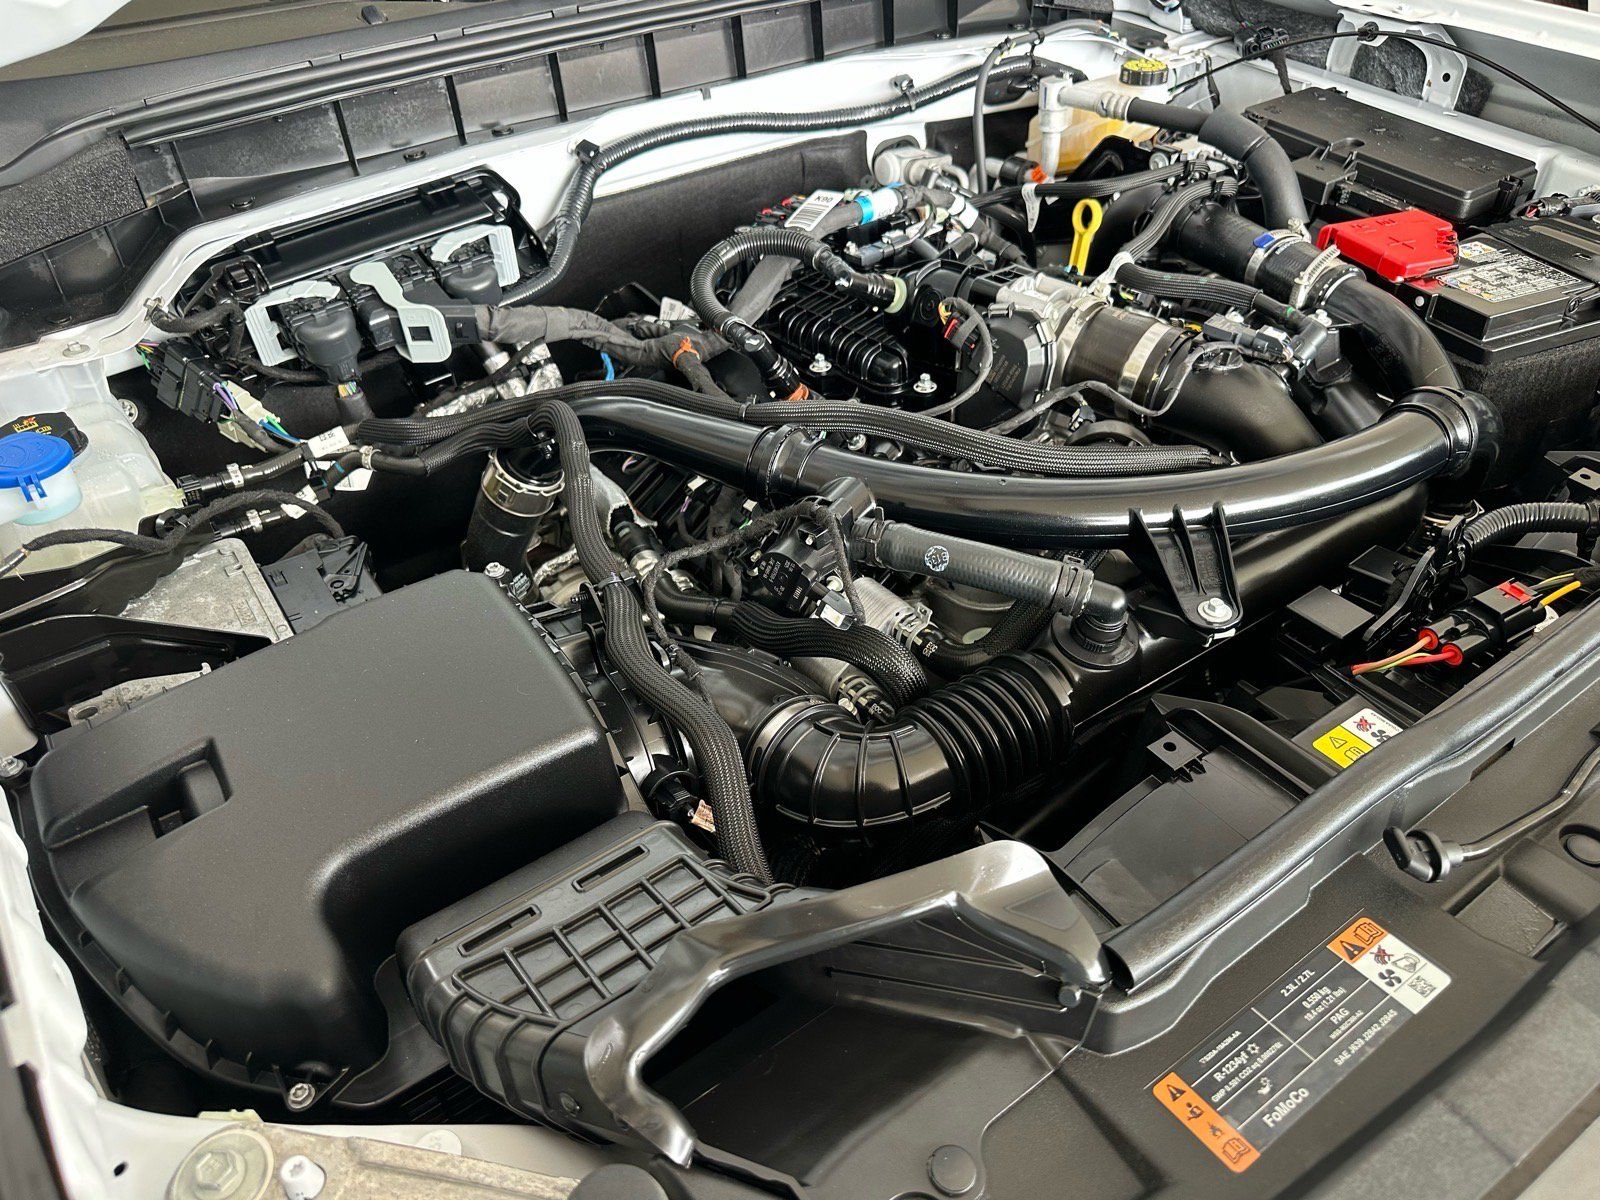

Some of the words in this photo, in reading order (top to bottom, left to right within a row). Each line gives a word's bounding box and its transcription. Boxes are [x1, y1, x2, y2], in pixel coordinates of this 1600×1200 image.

[1280, 983, 1299, 997] 2.3L
[1297, 969, 1315, 983] 2.7L
[1317, 986, 1332, 996] kg
[1315, 1005, 1325, 1013] oz
[1330, 1008, 1350, 1024] PAG
[1334, 1050, 1351, 1065] SAE
[1348, 1038, 1365, 1054] J639
[1362, 1023, 1382, 1041] J2842
[1379, 1009, 1398, 1027] J2845
[1213, 1051, 1249, 1082] R-1234yf
[1211, 1089, 1225, 1102] GWP
[1239, 1067, 1253, 1079] CO2
[1262, 1088, 1309, 1127] FoMoCo
